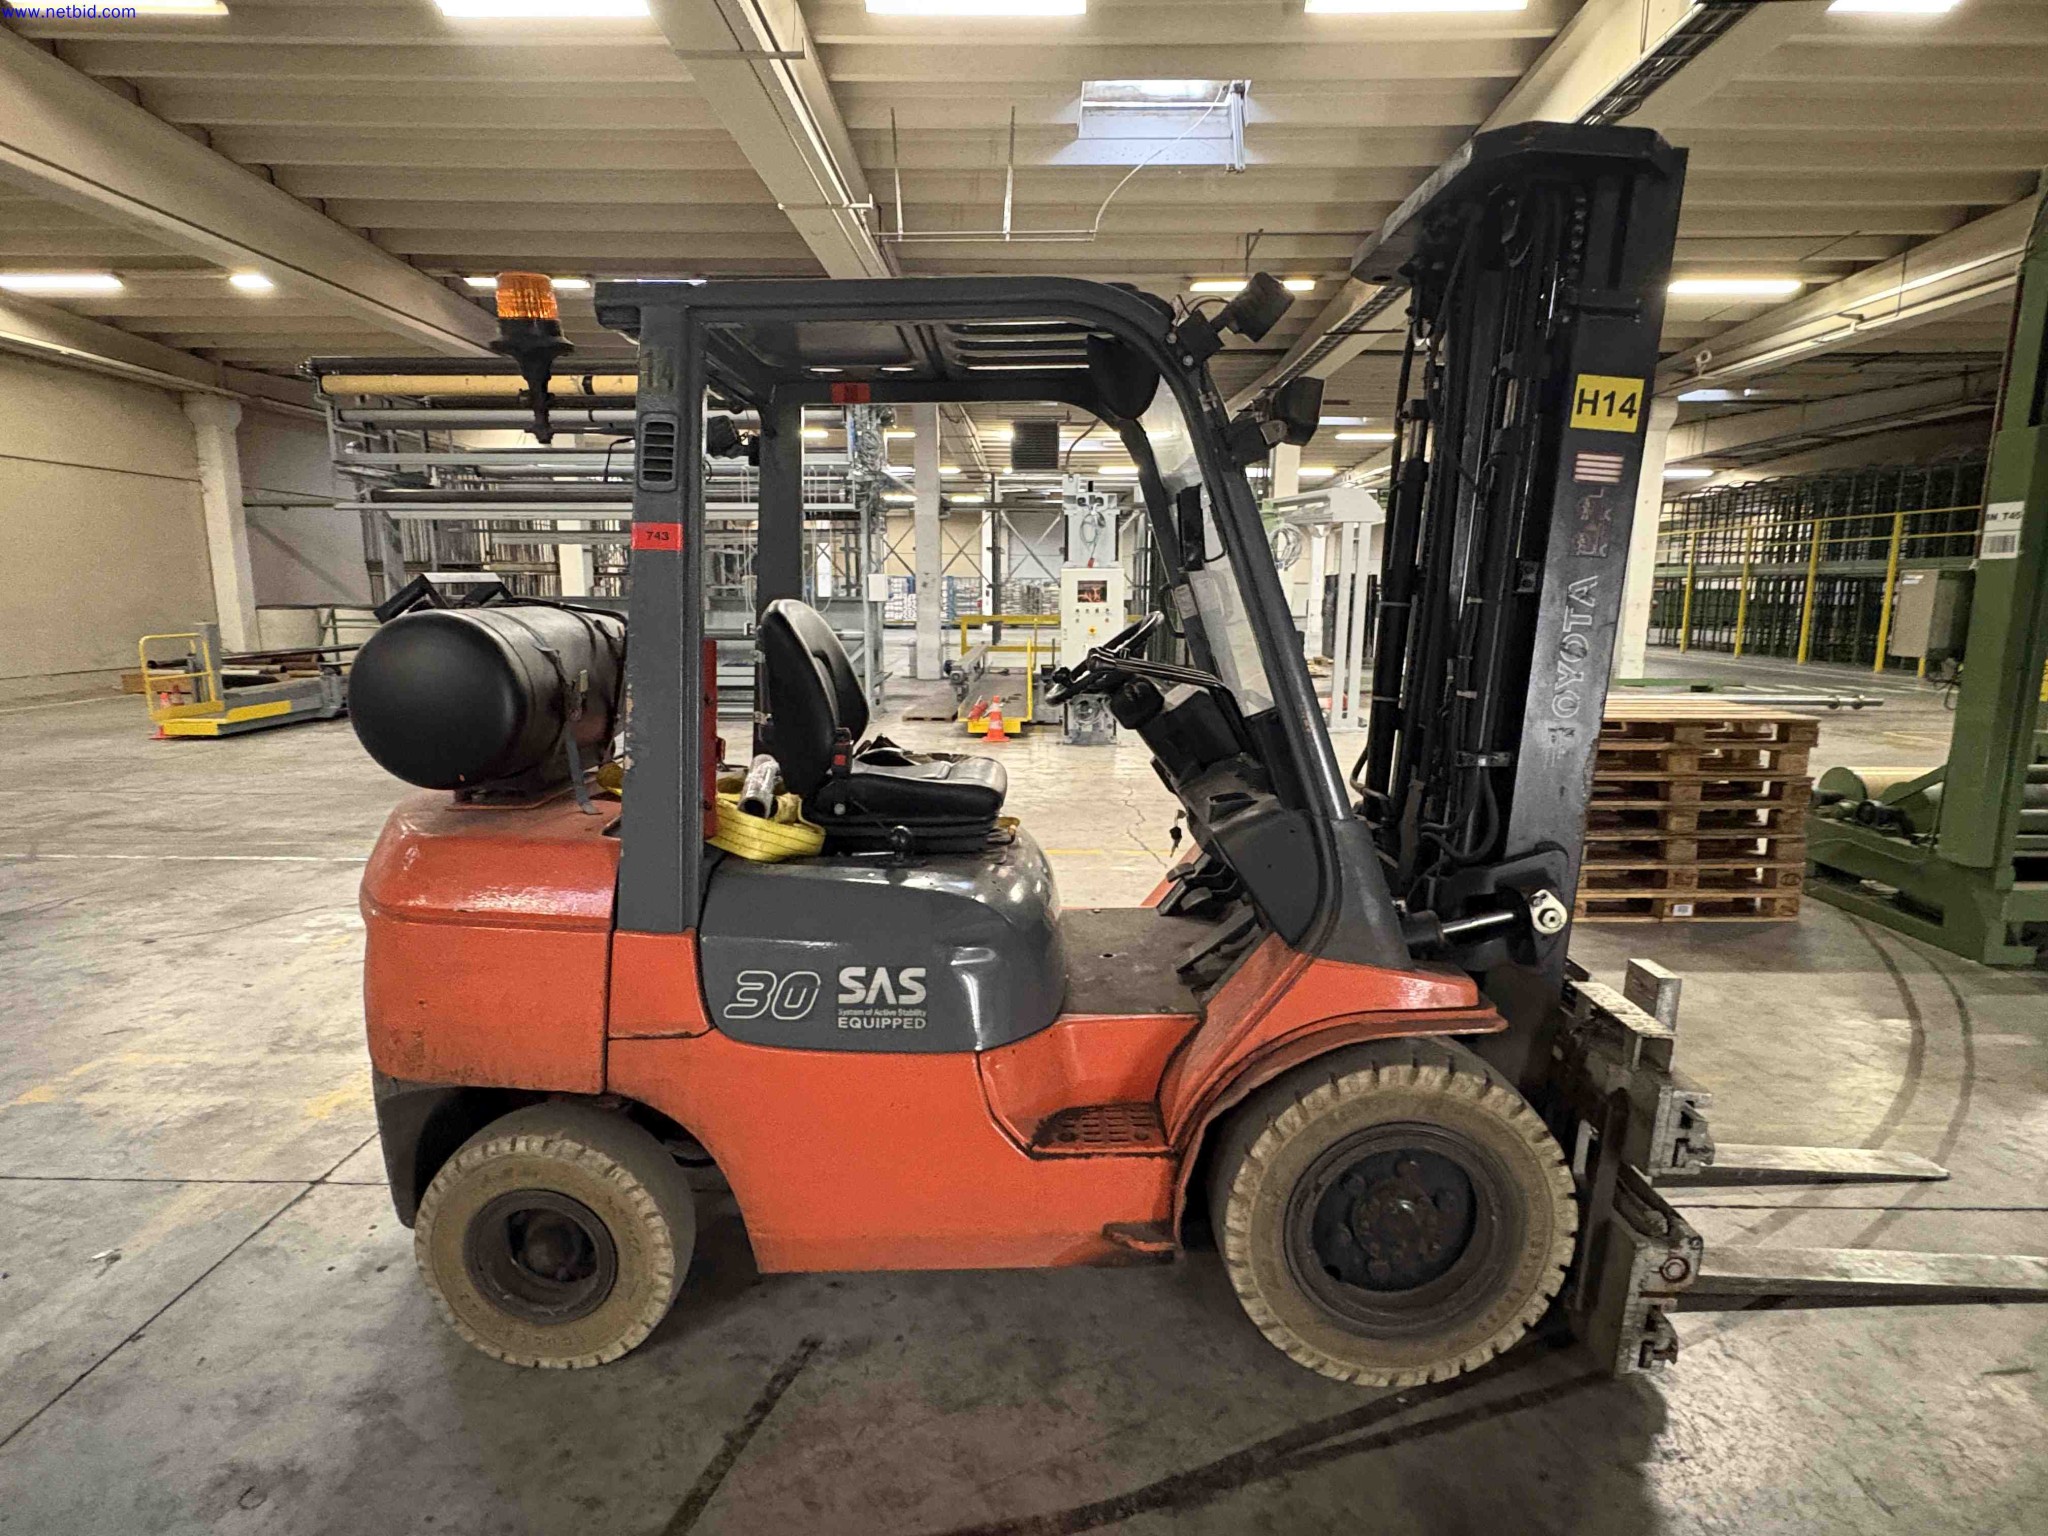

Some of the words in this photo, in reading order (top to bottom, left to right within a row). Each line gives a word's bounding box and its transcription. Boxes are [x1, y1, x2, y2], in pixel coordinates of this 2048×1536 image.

[1576, 388, 1637, 419] H14
[646, 531, 669, 541] 743
[1548, 575, 1599, 742] OYOTA
[723, 970, 821, 1020] 30
[838, 967, 926, 1005] SAS
[838, 1009, 865, 1017] System
[874, 1009, 896, 1017] Active
[898, 1009, 926, 1018] Stability
[838, 1017, 926, 1030] EQUIPPED
